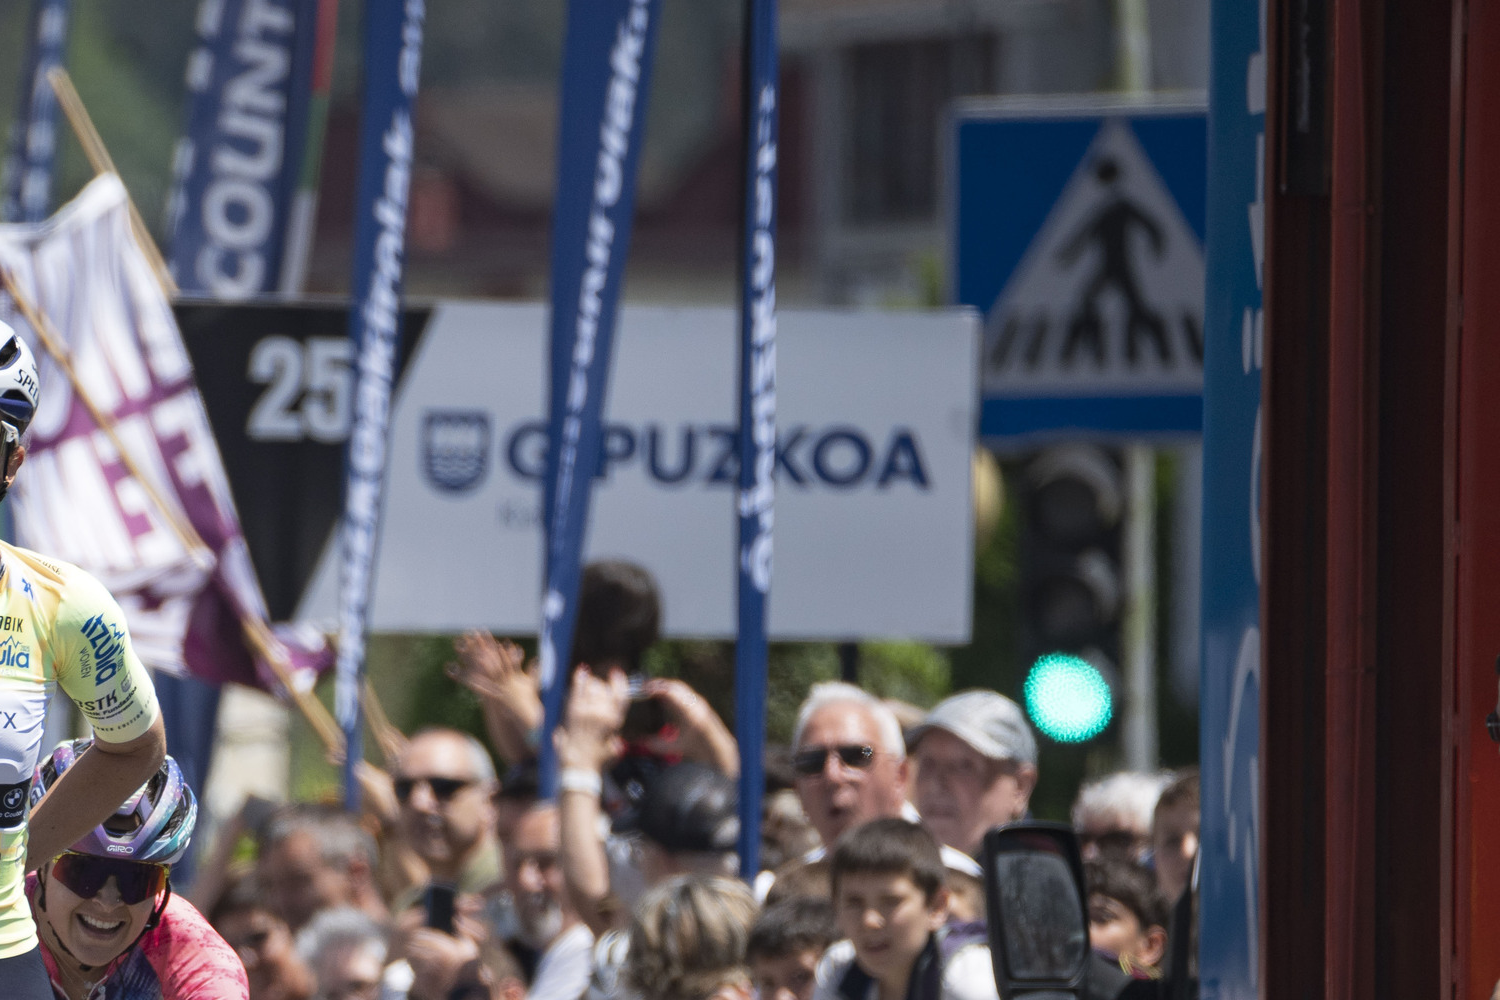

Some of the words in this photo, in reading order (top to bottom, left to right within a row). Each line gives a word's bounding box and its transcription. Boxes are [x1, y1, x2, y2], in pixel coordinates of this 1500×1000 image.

[247, 334, 352, 442] 25
[507, 424, 932, 493] GPUZKOA
[80, 646, 91, 679] WOMEN
